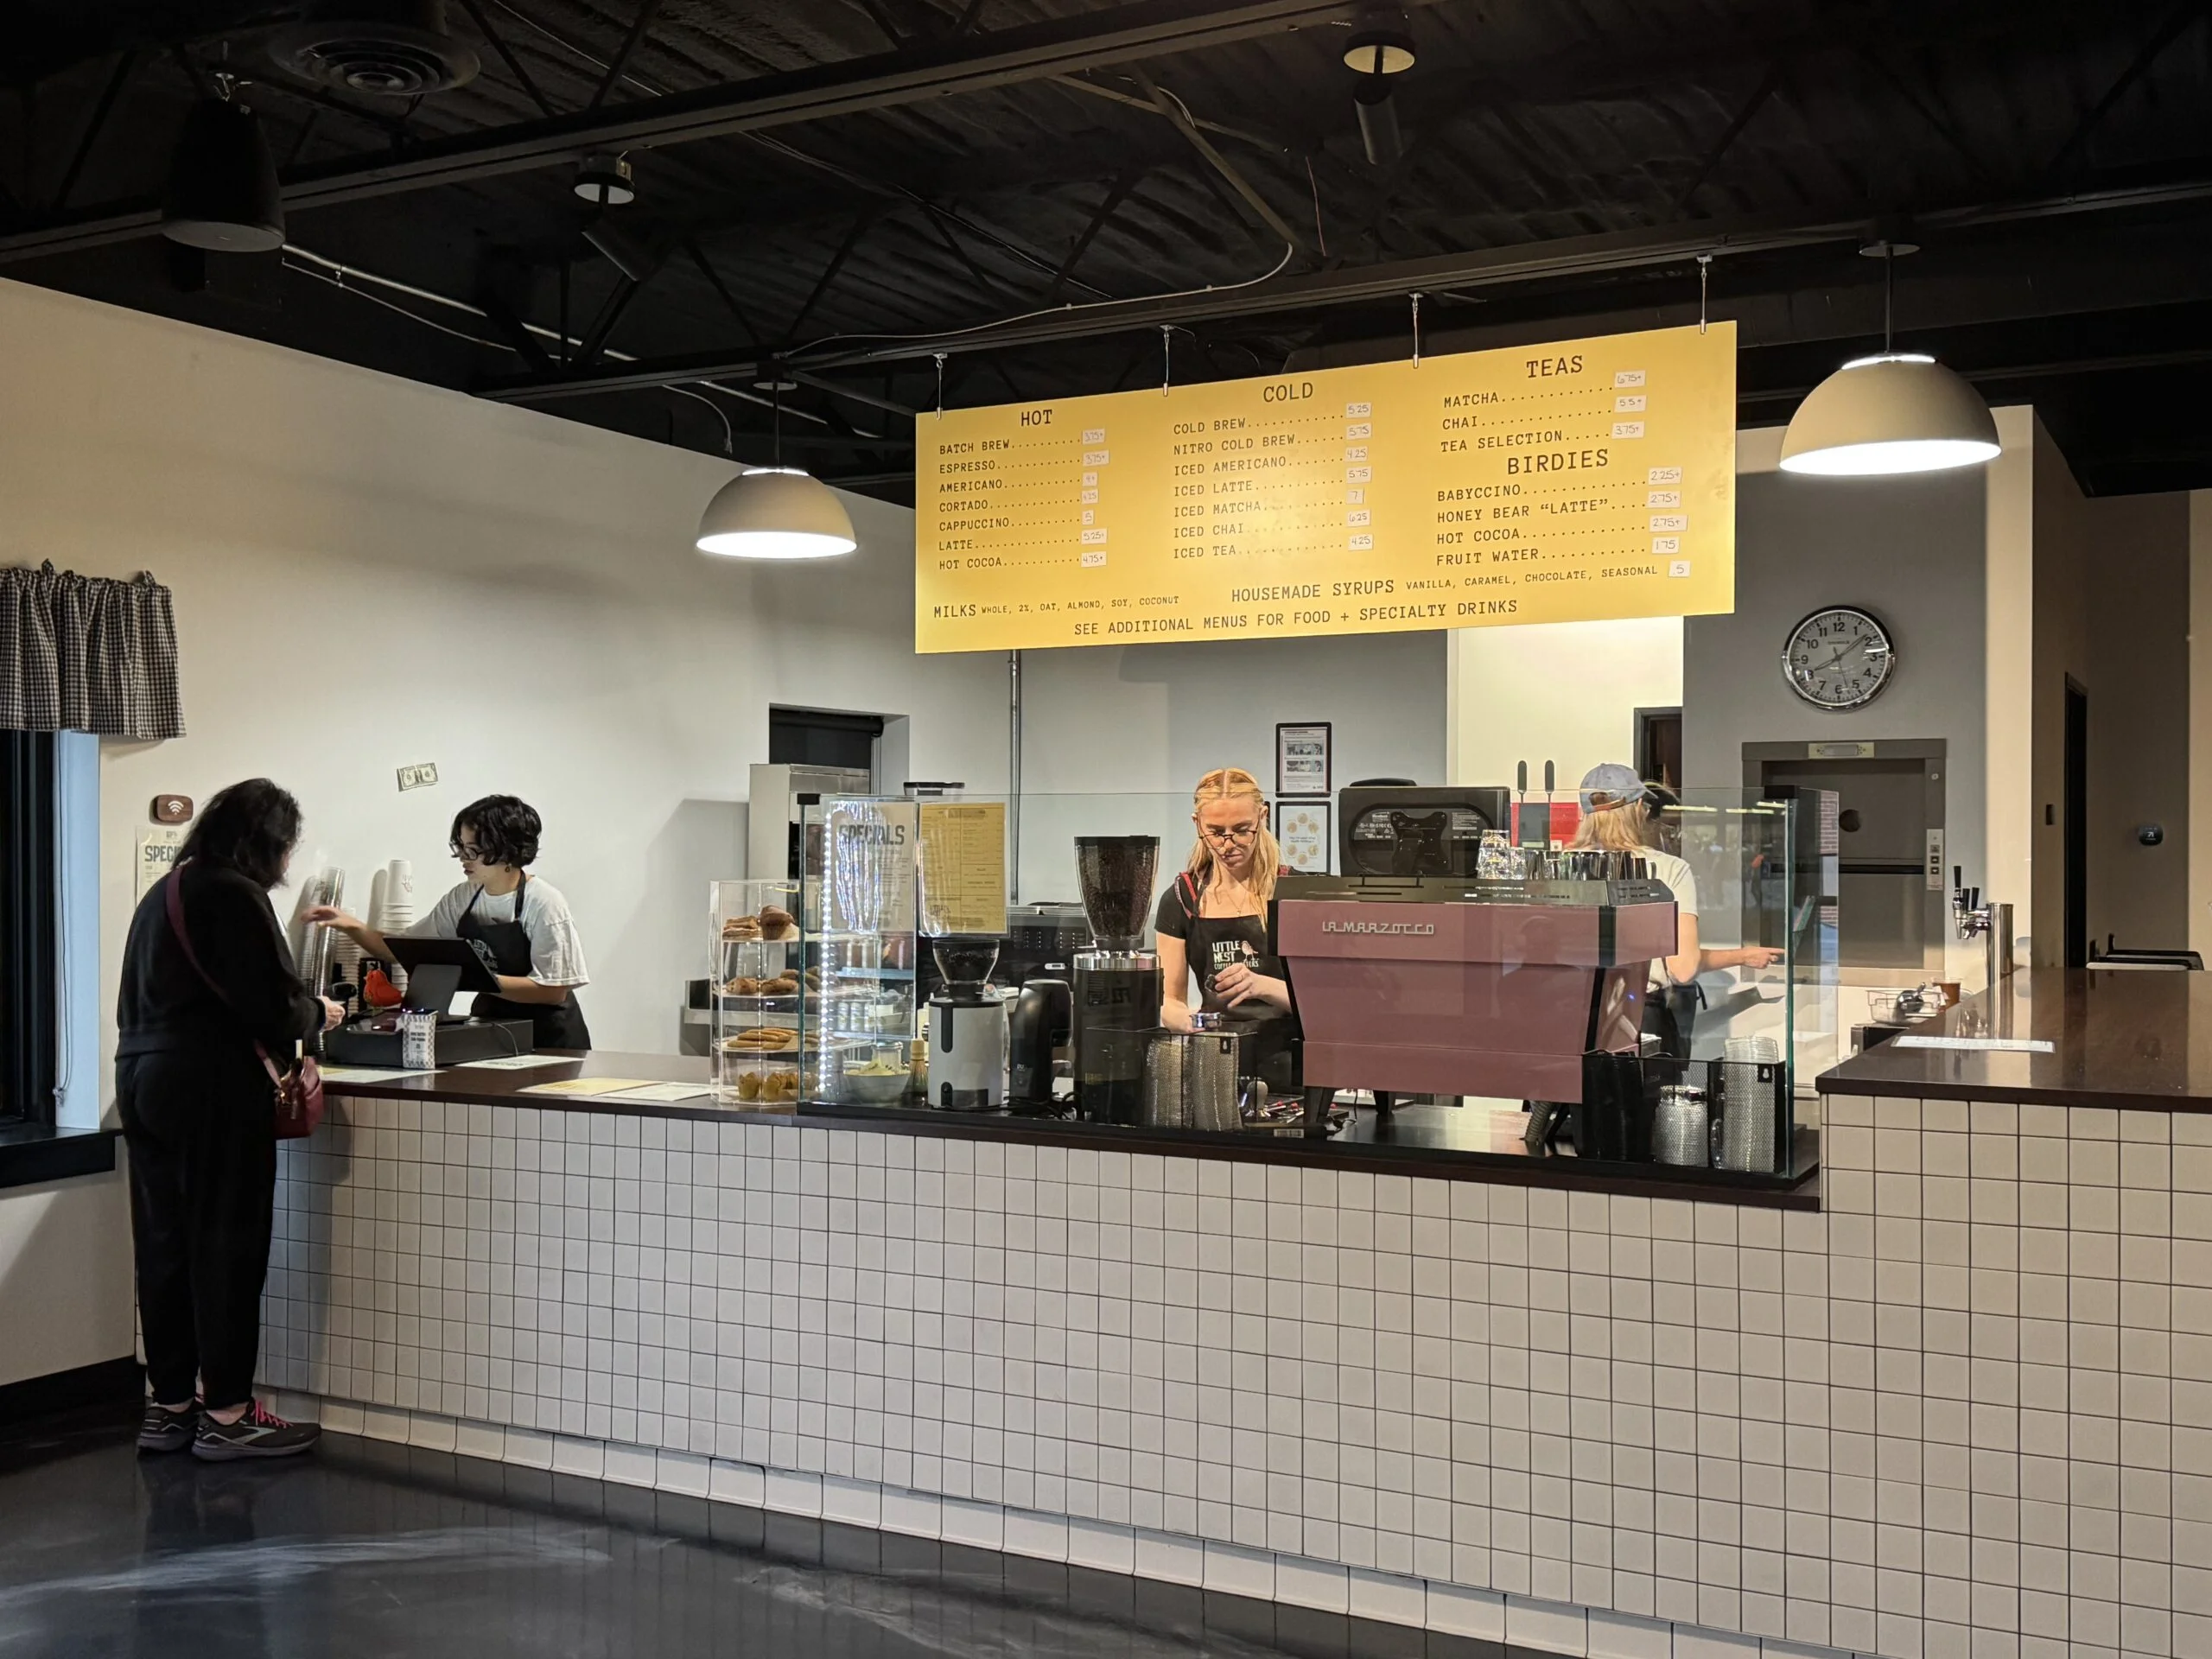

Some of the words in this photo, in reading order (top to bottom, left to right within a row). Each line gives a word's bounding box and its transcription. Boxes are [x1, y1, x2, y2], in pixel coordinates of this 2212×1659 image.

[1527, 355, 1582, 378] TEAS
[1263, 383, 1313, 402] COLD
[1445, 392, 1498, 408] MATCHA
[1021, 410, 1052, 426] HOT
[1443, 416, 1477, 429] CHAI
[1174, 423, 1205, 435] COLD
[1214, 418, 1245, 430] BREW
[940, 442, 973, 454] BATCH
[982, 439, 1009, 450] BREW
[1174, 442, 1212, 454] NITRO
[1222, 439, 1253, 450] COLD
[1263, 434, 1294, 447] BREW
[1441, 440, 1466, 452] TEA
[1478, 430, 1561, 448] SELECTION
[940, 461, 995, 474] ESPRESSO
[1175, 464, 1204, 476] ICED
[1213, 456, 1286, 473] AMERICANO
[1509, 449, 1607, 474] BIRDIES
[940, 480, 1001, 493] AMERICANO
[1175, 485, 1204, 496] ICED
[1214, 480, 1252, 493] LATTE
[1438, 484, 1520, 501] BABYCCINO
[940, 499, 988, 512] CORTADO
[1175, 505, 1204, 517] ICED
[1213, 501, 1260, 514] MATCHA
[1438, 509, 1482, 523] HONEY
[1494, 505, 1529, 518] BEAR
[939, 518, 1008, 531] CAPPUCCINO
[1174, 526, 1204, 537] ICED
[1213, 524, 1243, 535] CHAI
[1438, 532, 1463, 544] HOT
[1474, 529, 1519, 542] COCOA
[939, 540, 972, 550] LATTE
[1174, 547, 1204, 558] ICED
[1213, 545, 1236, 556] TEA
[940, 560, 959, 569] HOT
[967, 557, 1001, 568] COCOA
[1437, 553, 1481, 566] FRUIT
[1492, 549, 1538, 562] WATER
[1232, 584, 1320, 601] HOUSEMADE
[1333, 580, 1394, 595] SYRUPS
[1602, 566, 1656, 577] SEASONAL
[934, 605, 976, 618] MILKS
[1140, 596, 1179, 605] COCONUT
[1075, 623, 1098, 635] SEE
[1109, 619, 1193, 633] ADDITIONAL
[1204, 615, 1247, 628] MENUS
[1258, 613, 1283, 626] FOR
[1294, 611, 1330, 624] FOOD
[1341, 613, 1349, 621] +
[1360, 604, 1446, 620] SPECIALTY
[1459, 601, 1516, 614] DRINKS
[1819, 627, 1827, 637] 11
[1833, 622, 1845, 632] 12
[1853, 626, 1858, 635] 1
[1807, 639, 1819, 649] 10
[1865, 637, 1872, 646] 2
[1801, 655, 1808, 664] 9
[1863, 668, 1872, 677] 4
[1819, 681, 1827, 690] 7
[1835, 685, 1843, 695] 6
[1853, 680, 1859, 689] 5
[1212, 940, 1241, 952] LITTLE
[1213, 951, 1235, 963] NEST
